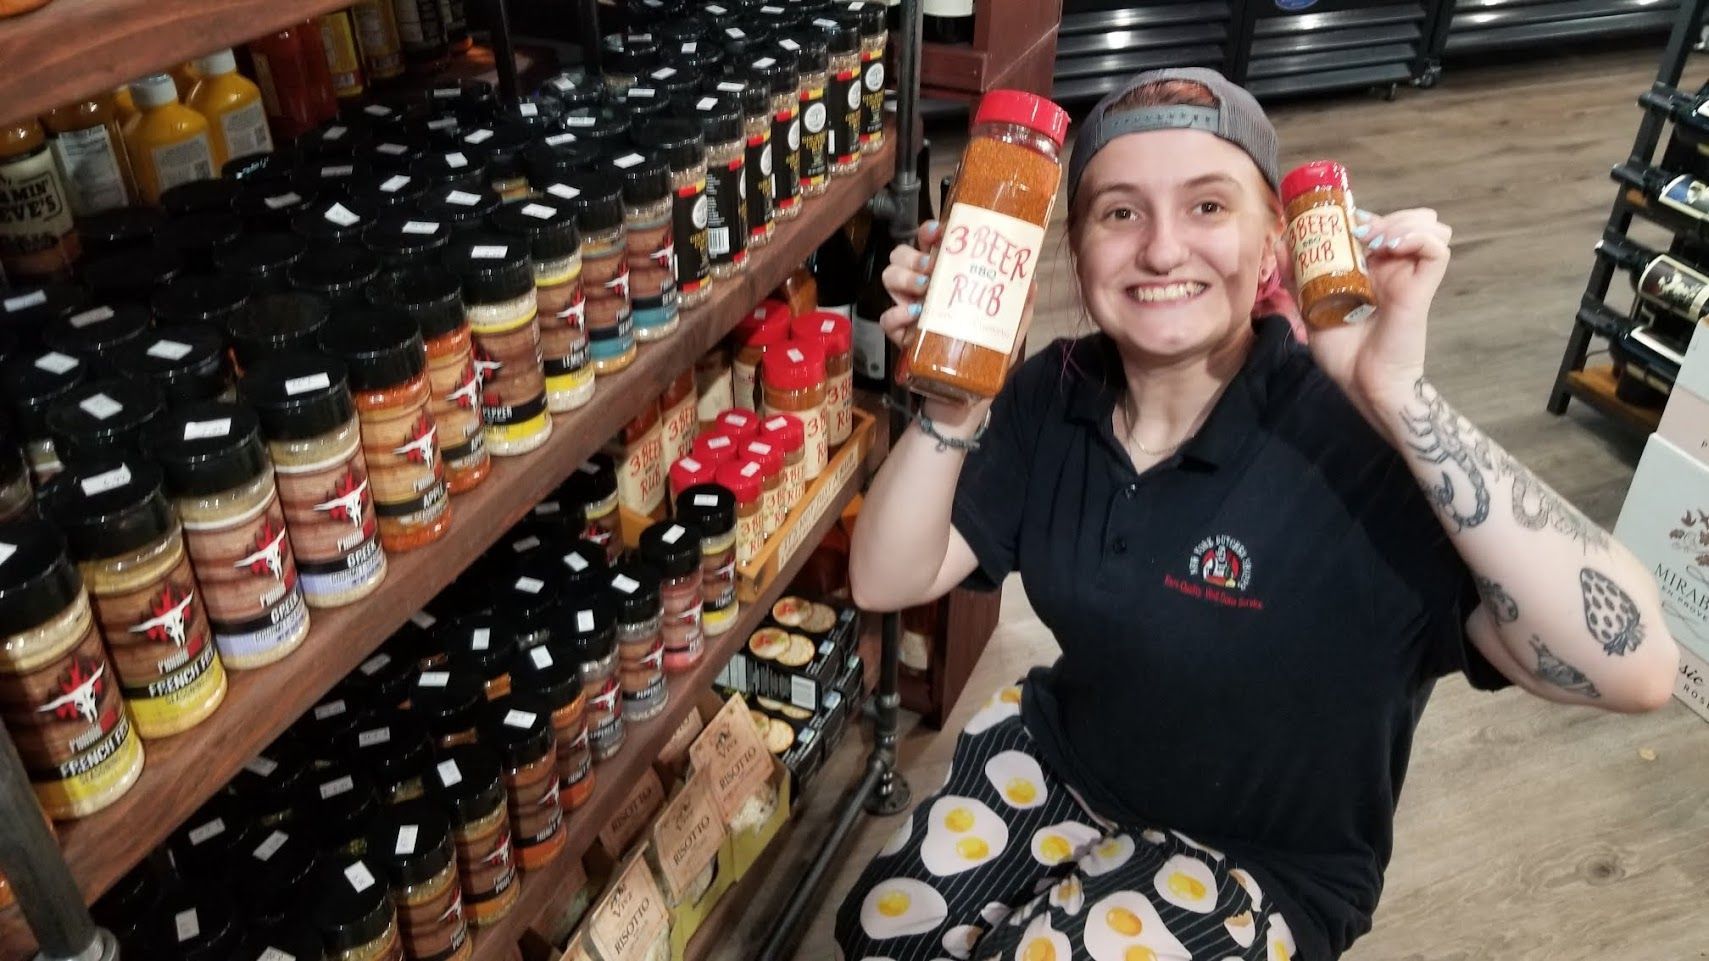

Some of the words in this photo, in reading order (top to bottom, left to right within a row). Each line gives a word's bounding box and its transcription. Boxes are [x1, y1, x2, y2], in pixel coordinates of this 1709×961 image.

[1296, 214, 1343, 242] BEER
[944, 225, 970, 255] 3
[969, 225, 1032, 282] BEER
[969, 263, 997, 281] BBQ
[1298, 240, 1336, 275] RUB
[947, 273, 1006, 317] RUB
[827, 384, 839, 405] 3
[668, 420, 679, 442] 3
[807, 418, 819, 438] 3
[629, 453, 641, 478] 3
[641, 463, 661, 502] RUB
[148, 660, 200, 698] FRENCH
[60, 736, 115, 779] FRENCH
[719, 746, 757, 791] RISOTTO
[610, 787, 652, 834] RISOTTO
[672, 814, 711, 867] RISOTTO
[614, 896, 651, 957] RISOTTO
